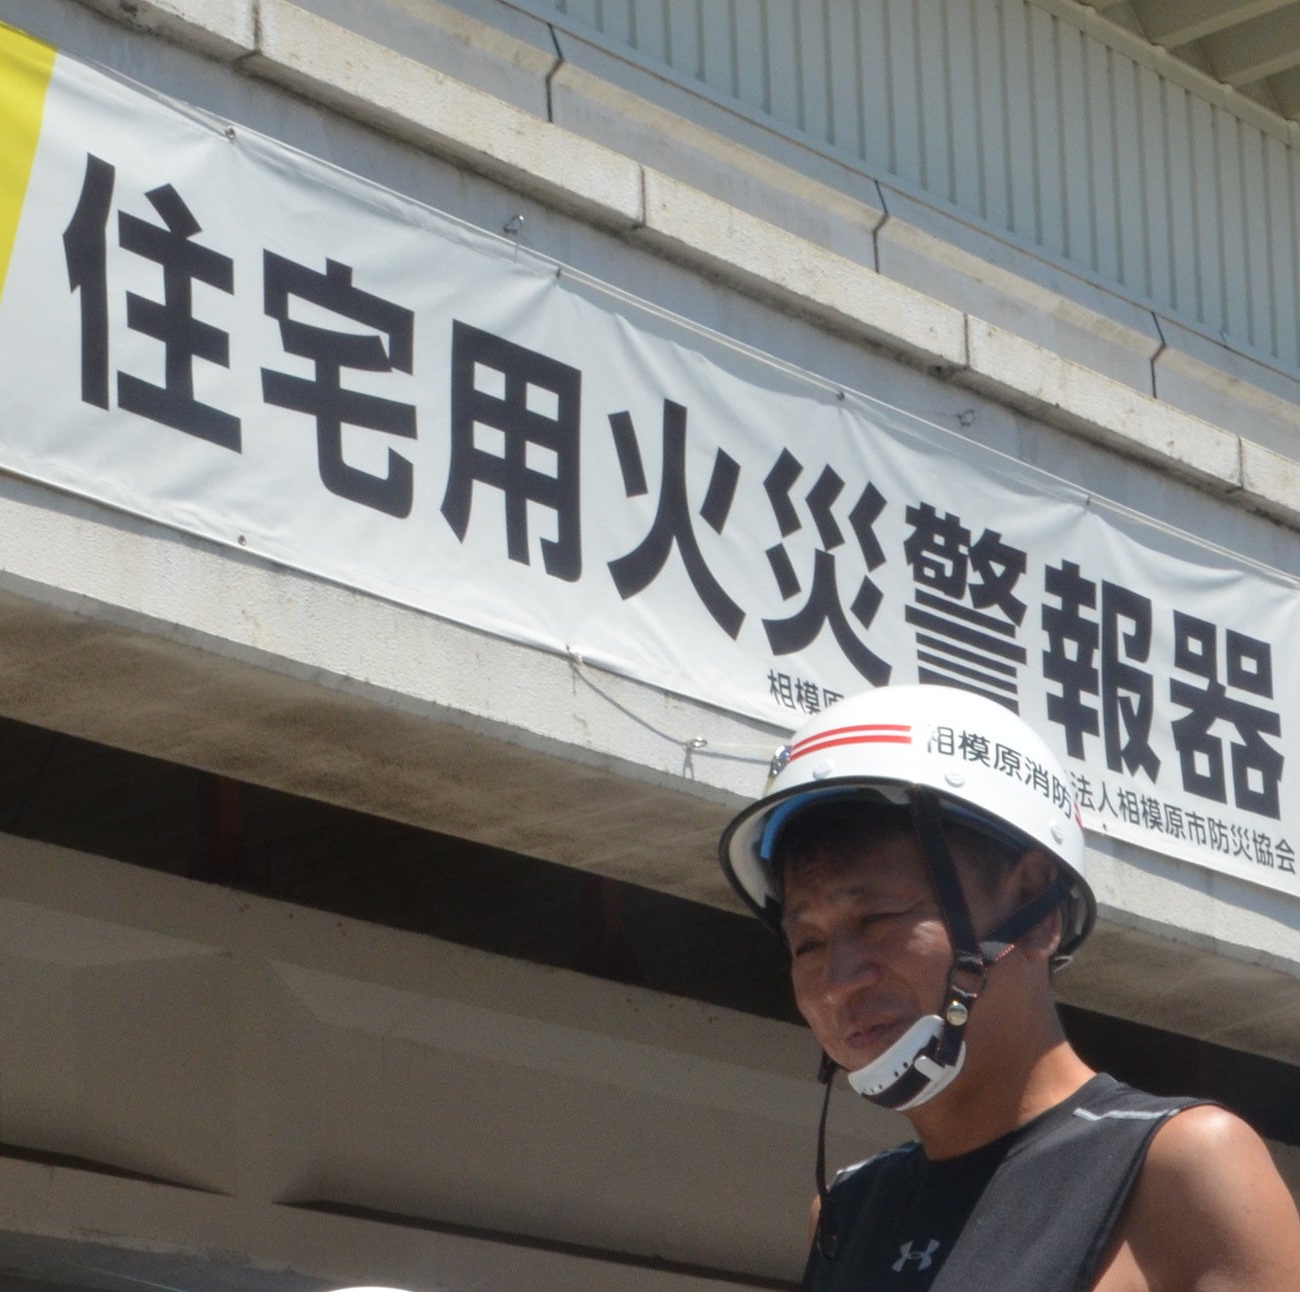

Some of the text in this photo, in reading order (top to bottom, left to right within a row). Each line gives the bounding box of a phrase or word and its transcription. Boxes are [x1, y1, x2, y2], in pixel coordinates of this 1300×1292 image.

[62, 151, 1286, 821] 住宅用火災警報器
[1070, 771, 1296, 875] 法人相模原市防災協会
